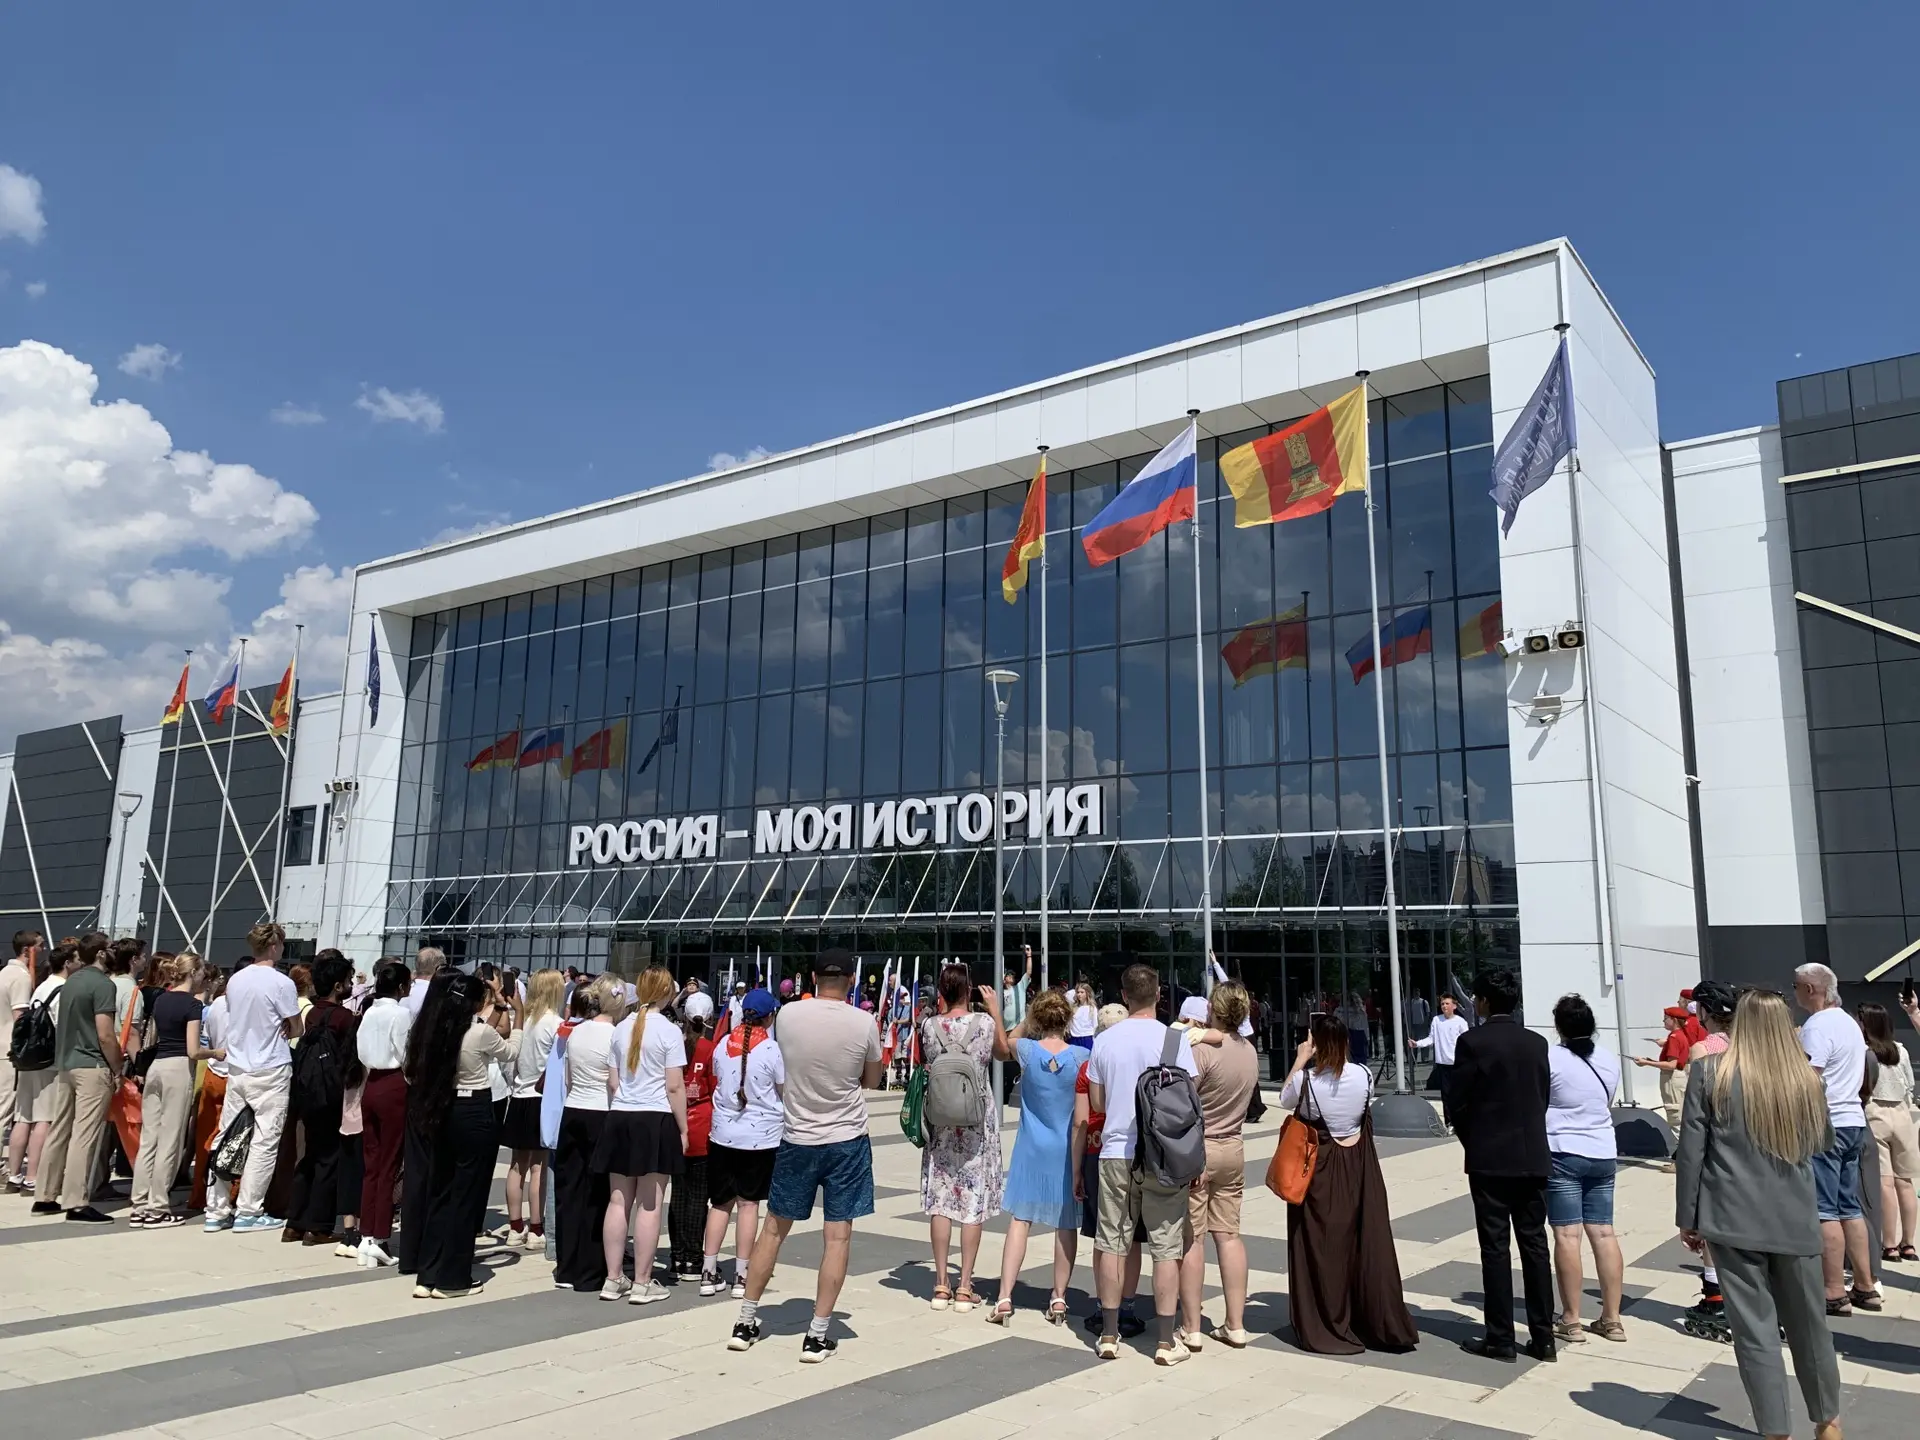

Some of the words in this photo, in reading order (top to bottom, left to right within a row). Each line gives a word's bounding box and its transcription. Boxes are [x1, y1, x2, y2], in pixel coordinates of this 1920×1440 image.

[569, 815, 718, 866] РОССИЯ
[755, 804, 852, 854] МОЯ
[862, 784, 1101, 848] ИСТОРИЯ
